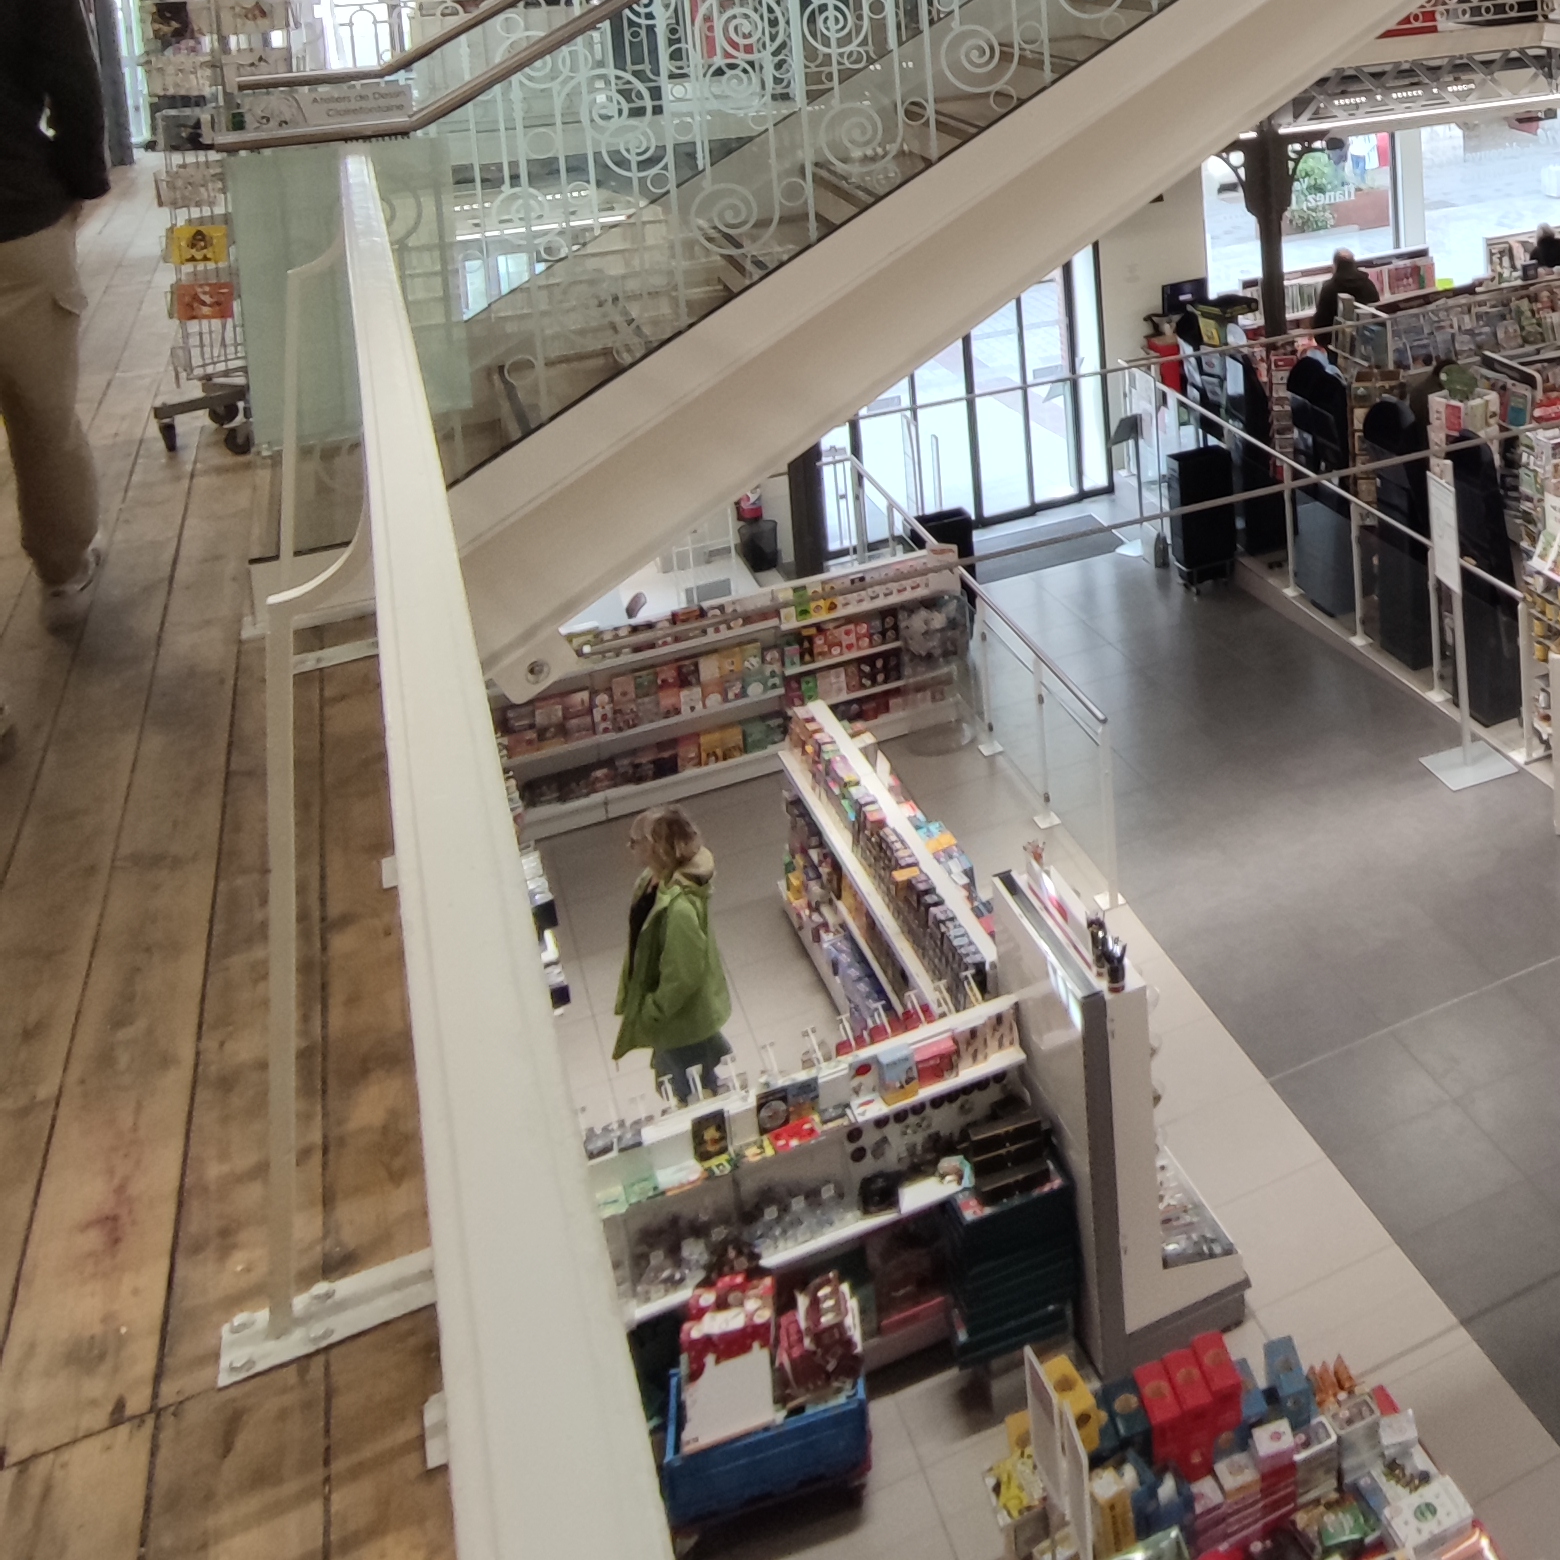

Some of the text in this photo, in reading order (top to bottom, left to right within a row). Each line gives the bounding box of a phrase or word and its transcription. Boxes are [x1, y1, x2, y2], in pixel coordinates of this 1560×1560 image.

[311, 89, 407, 105] Ateliers de Dessin
[325, 103, 404, 118] Clairefontaine
